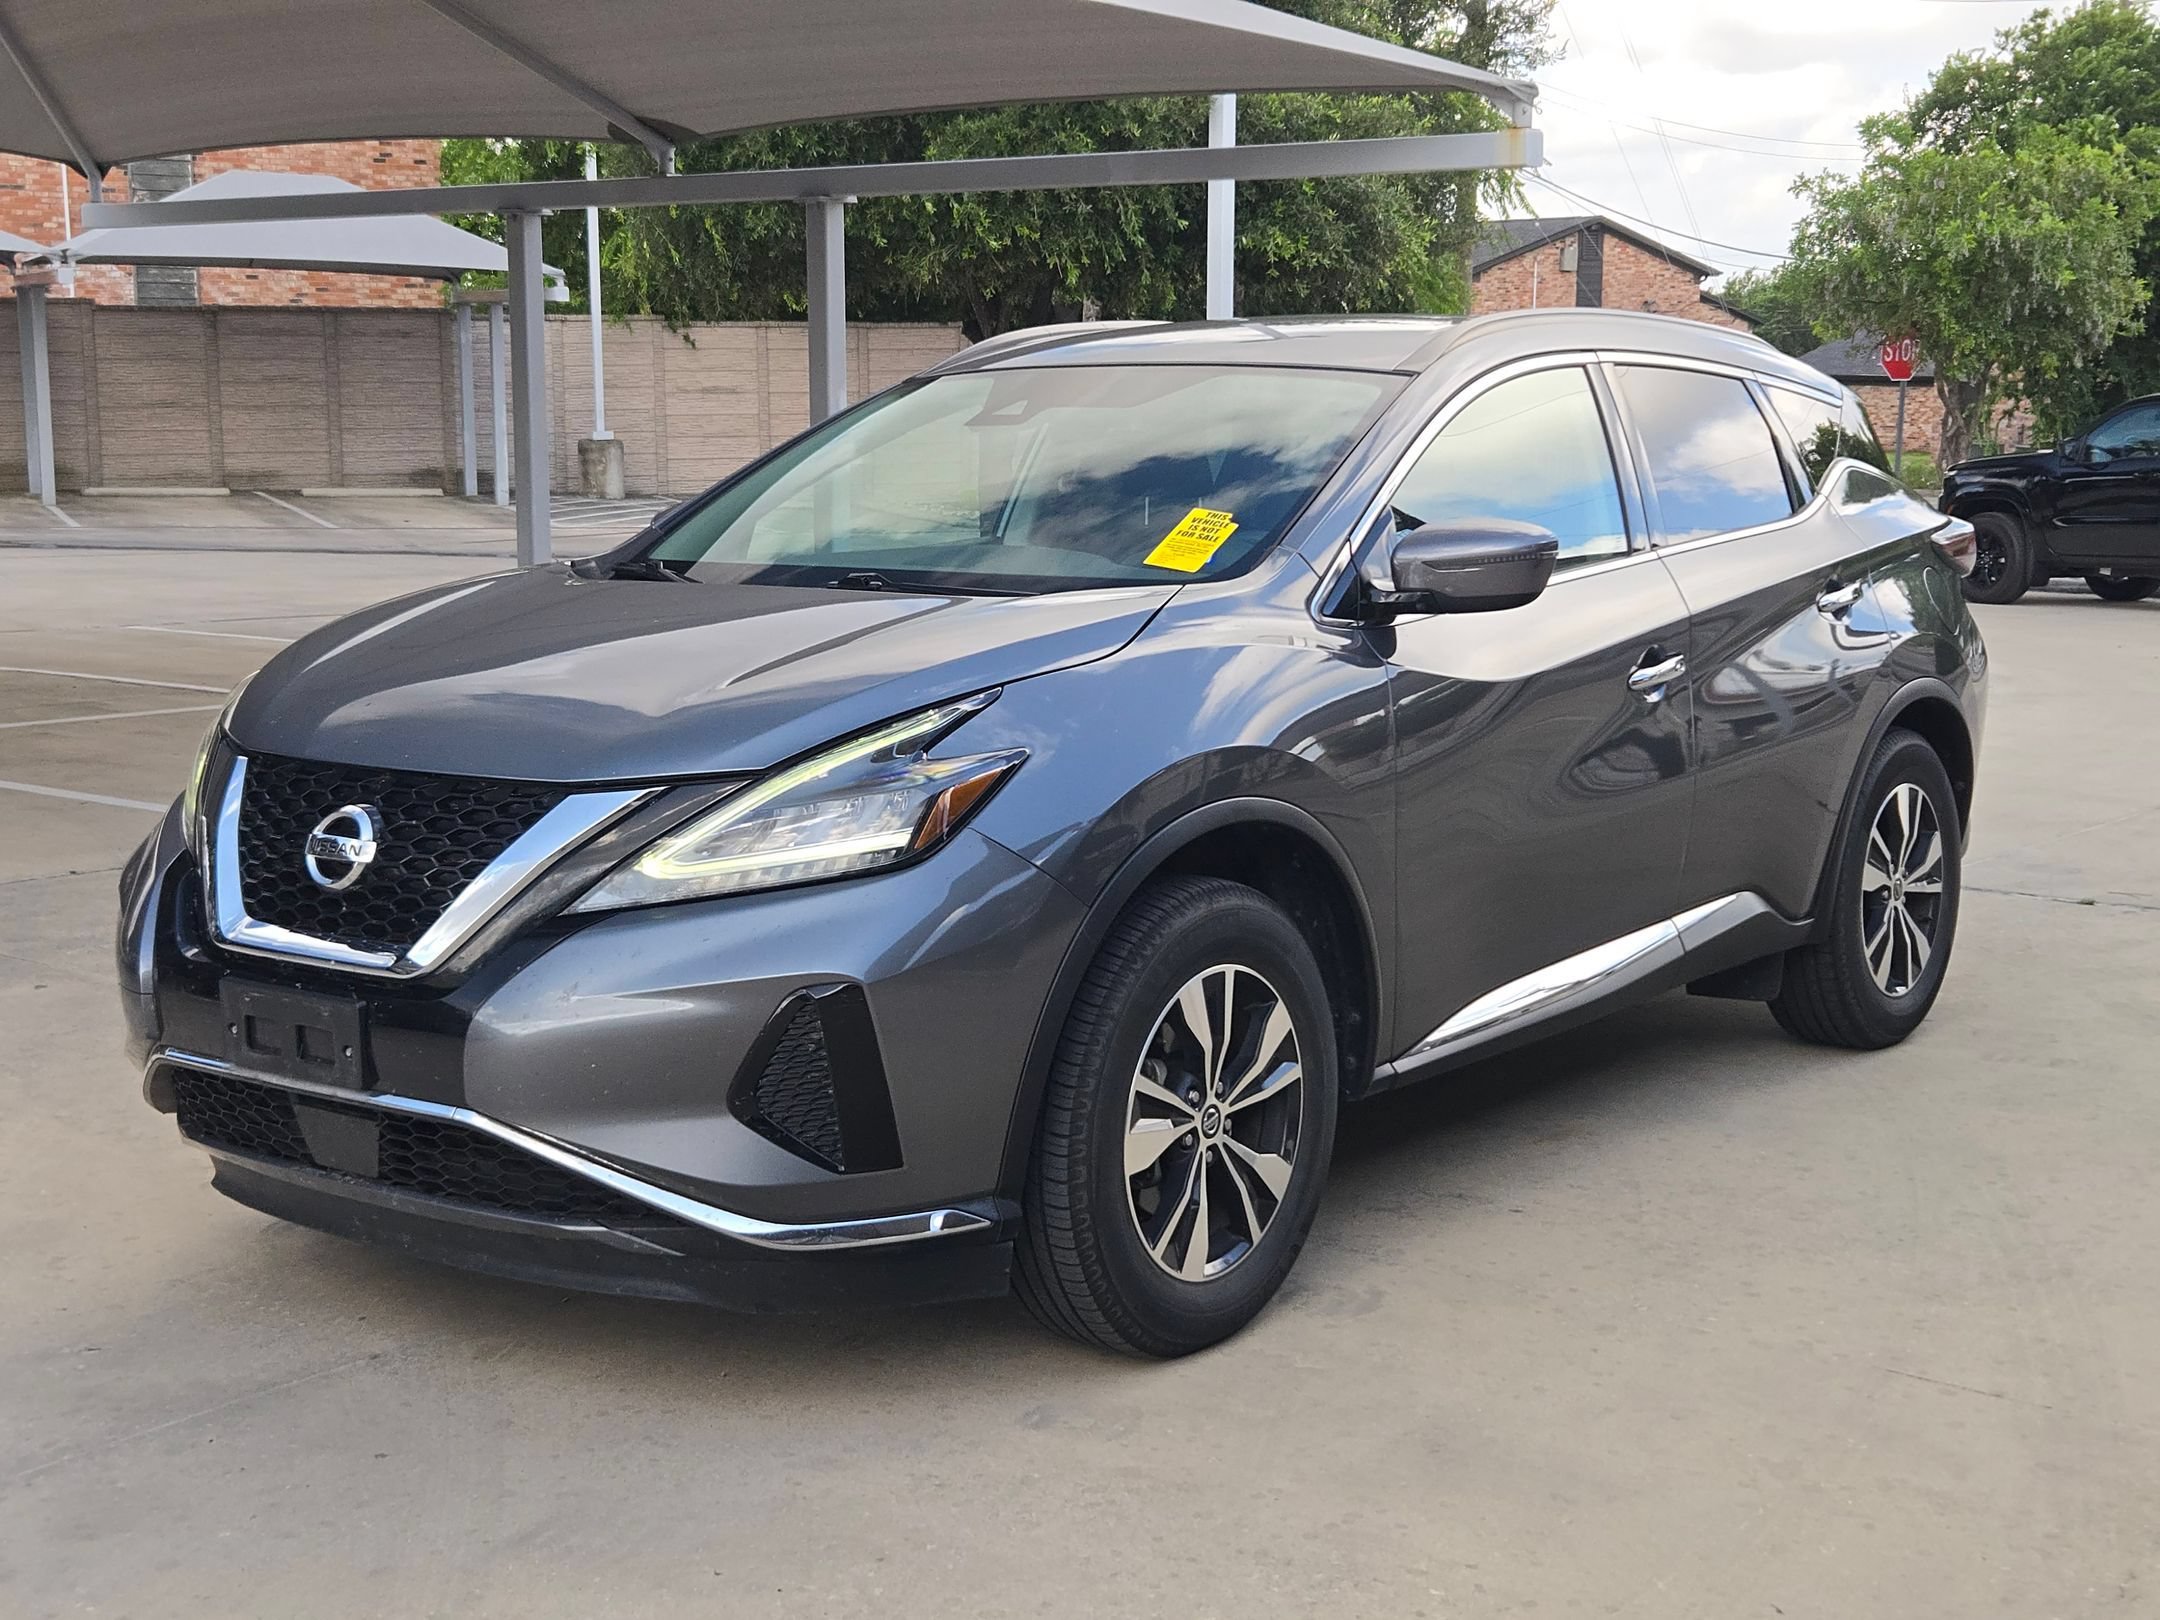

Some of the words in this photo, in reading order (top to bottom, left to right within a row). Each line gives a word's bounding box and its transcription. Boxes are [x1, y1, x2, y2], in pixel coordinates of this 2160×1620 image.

[1206, 512, 1229, 520] THIS
[1191, 517, 1230, 528] VEHICLE
[1200, 526, 1221, 534] NOT
[1176, 530, 1195, 538] FOR
[1196, 533, 1219, 542] SALE
